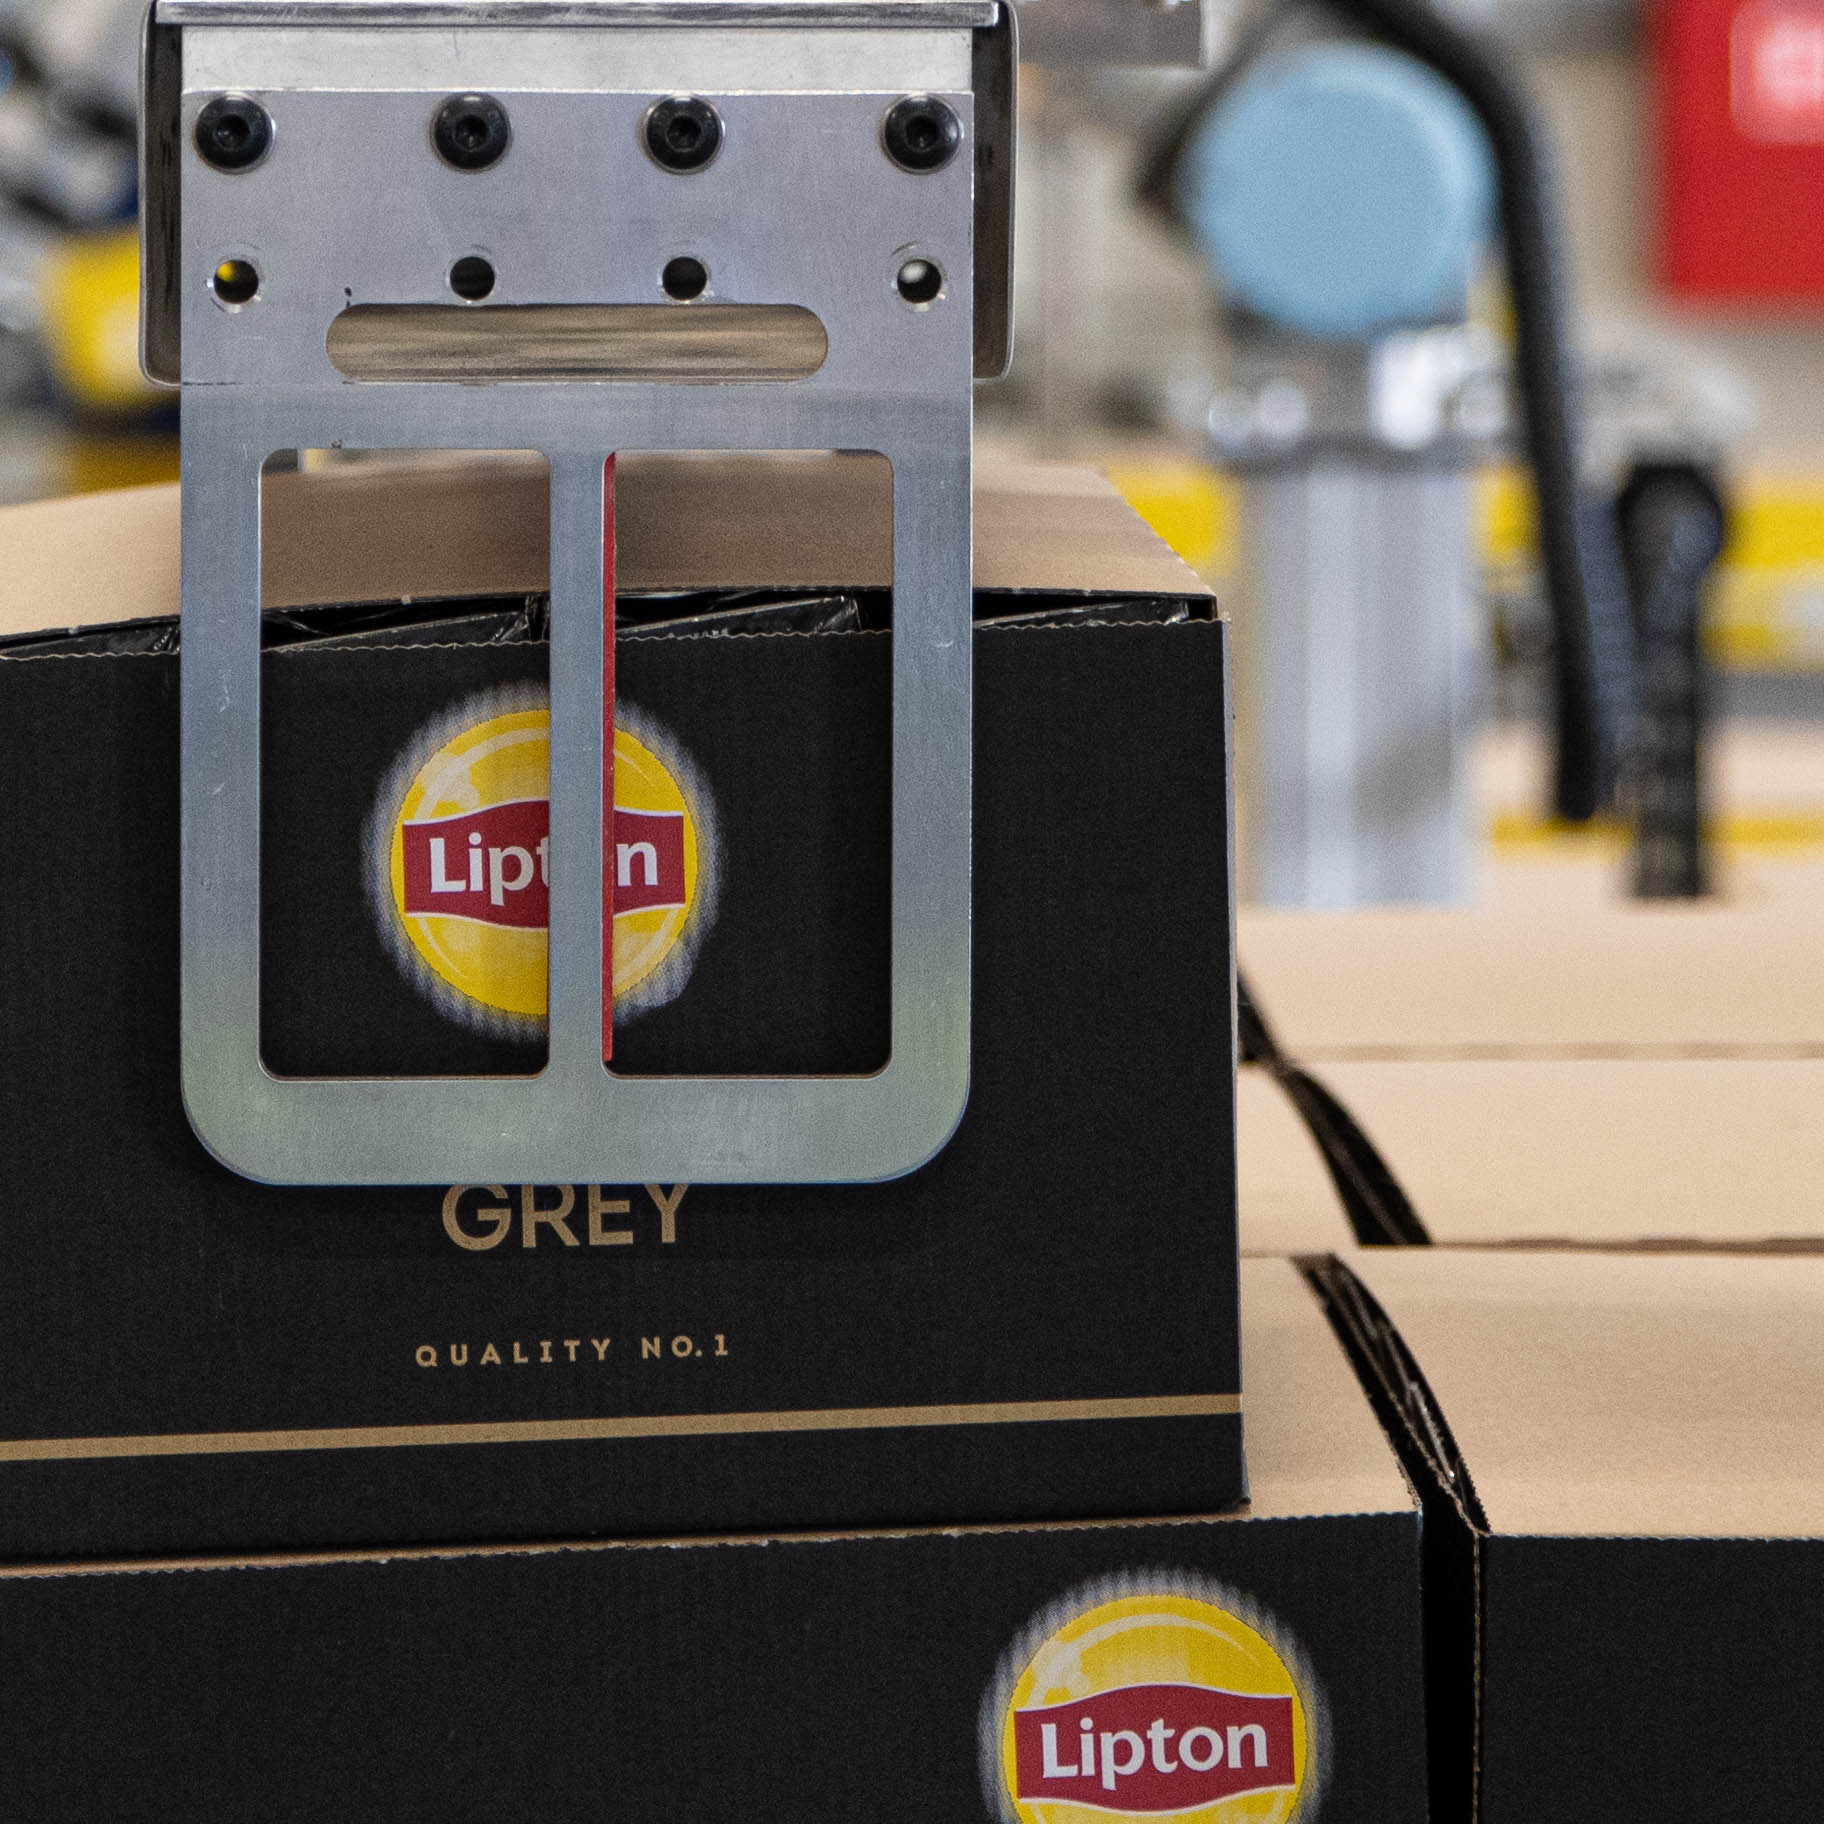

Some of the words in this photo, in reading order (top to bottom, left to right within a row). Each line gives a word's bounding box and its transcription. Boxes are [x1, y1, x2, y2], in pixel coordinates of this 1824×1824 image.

[428, 831, 659, 907] Liptn
[441, 1183, 690, 1251] GREY
[415, 1338, 612, 1368] QUALITY
[1040, 1717, 1269, 1791] Lipton
